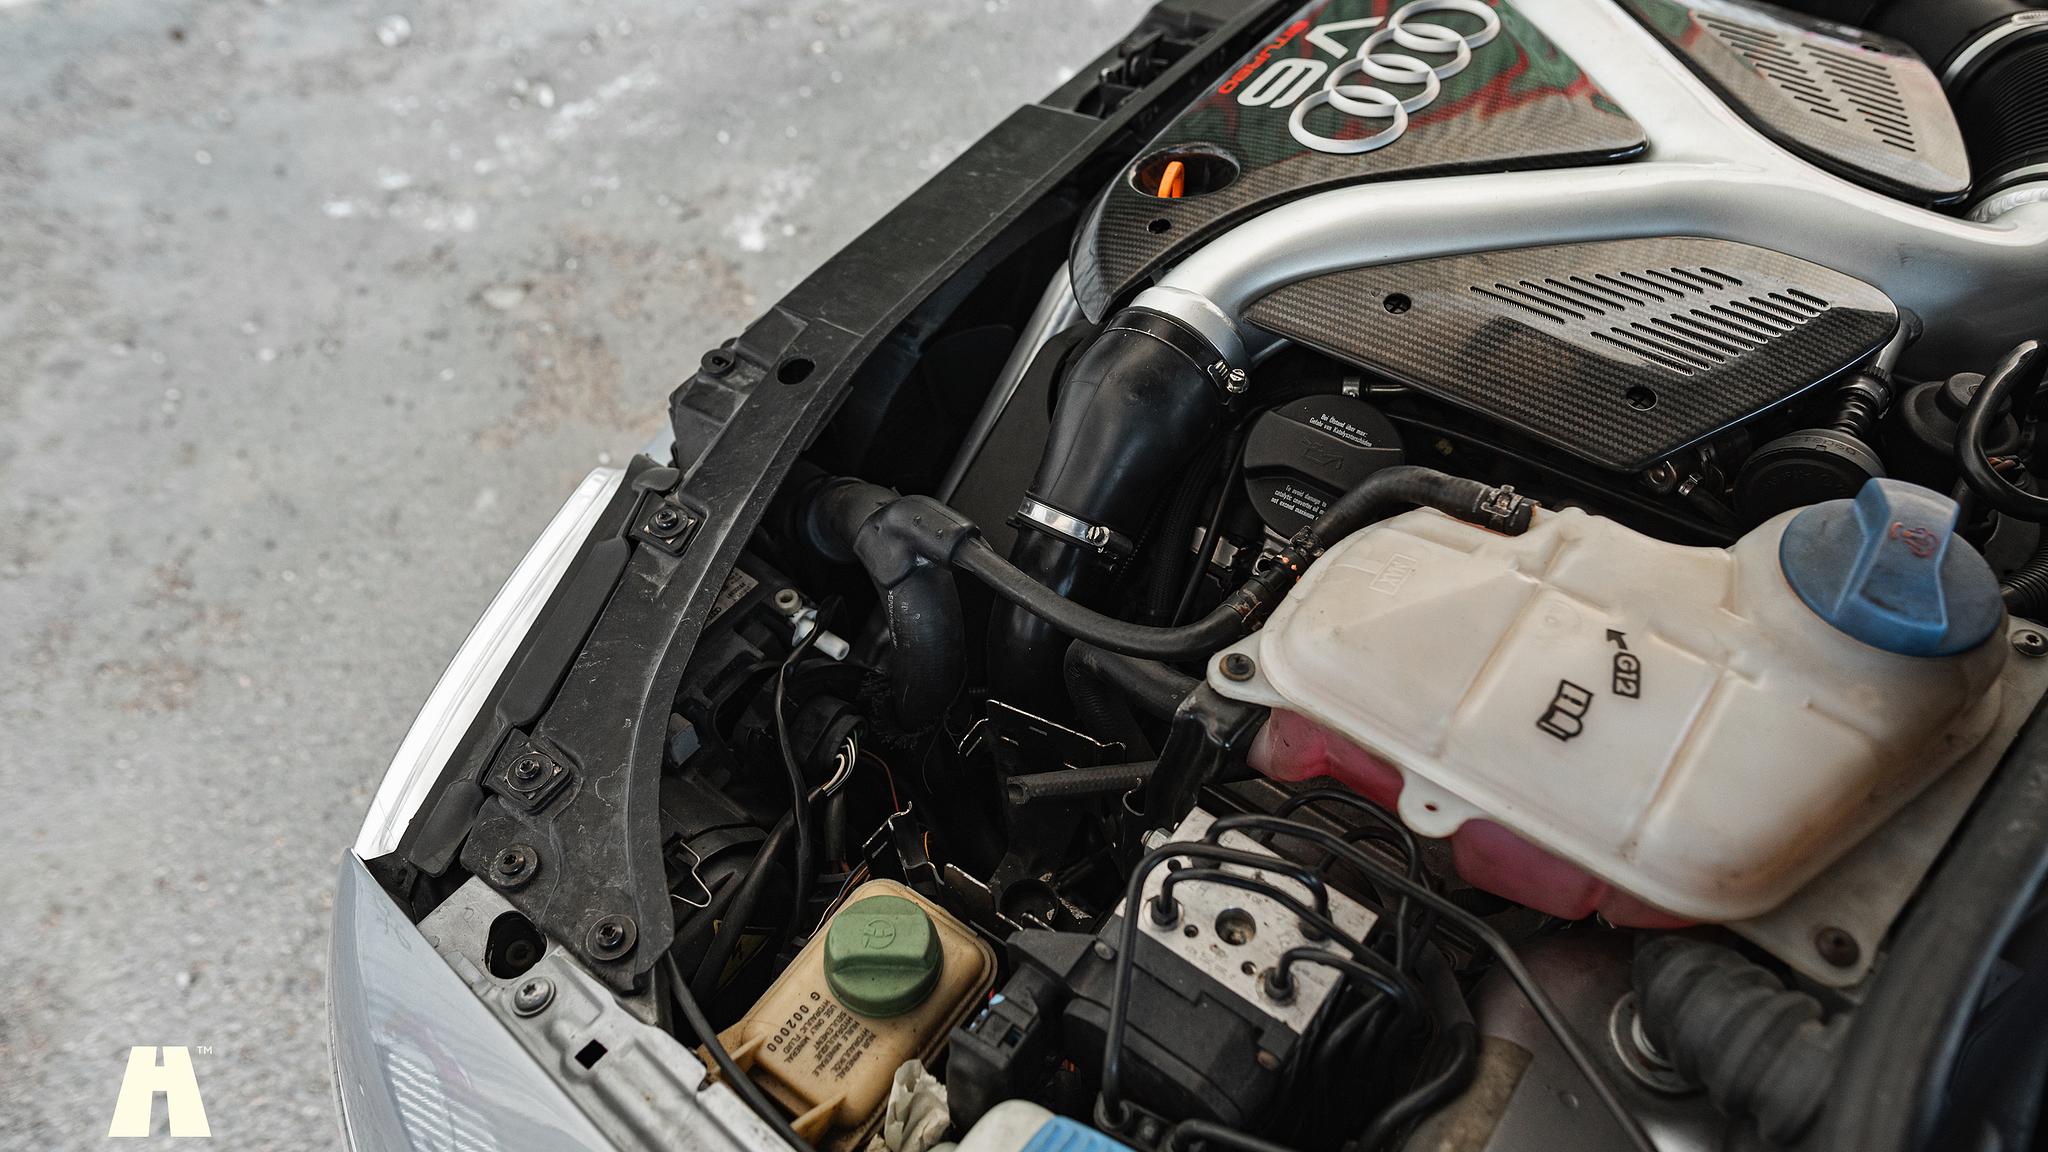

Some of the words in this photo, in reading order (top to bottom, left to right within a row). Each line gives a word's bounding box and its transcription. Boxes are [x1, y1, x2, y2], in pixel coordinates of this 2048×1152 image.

[1237, 16, 1385, 108] V6
[1292, 488, 1304, 497] avoid
[1303, 493, 1321, 505] damage
[1615, 656, 1636, 696] G12
[810, 991, 820, 1001] G
[799, 1000, 830, 1034] HYDRAULIC
[823, 1004, 837, 1018] USE
[767, 1005, 809, 1052] 002000
[809, 1019, 824, 1035] ONLY
[813, 1011, 846, 1050] SEULEMENT
[841, 1020, 860, 1041] HUILE
[782, 1035, 801, 1054] FLUID
[784, 1036, 810, 1063] MINERAL
[861, 1032, 877, 1049] NUR
